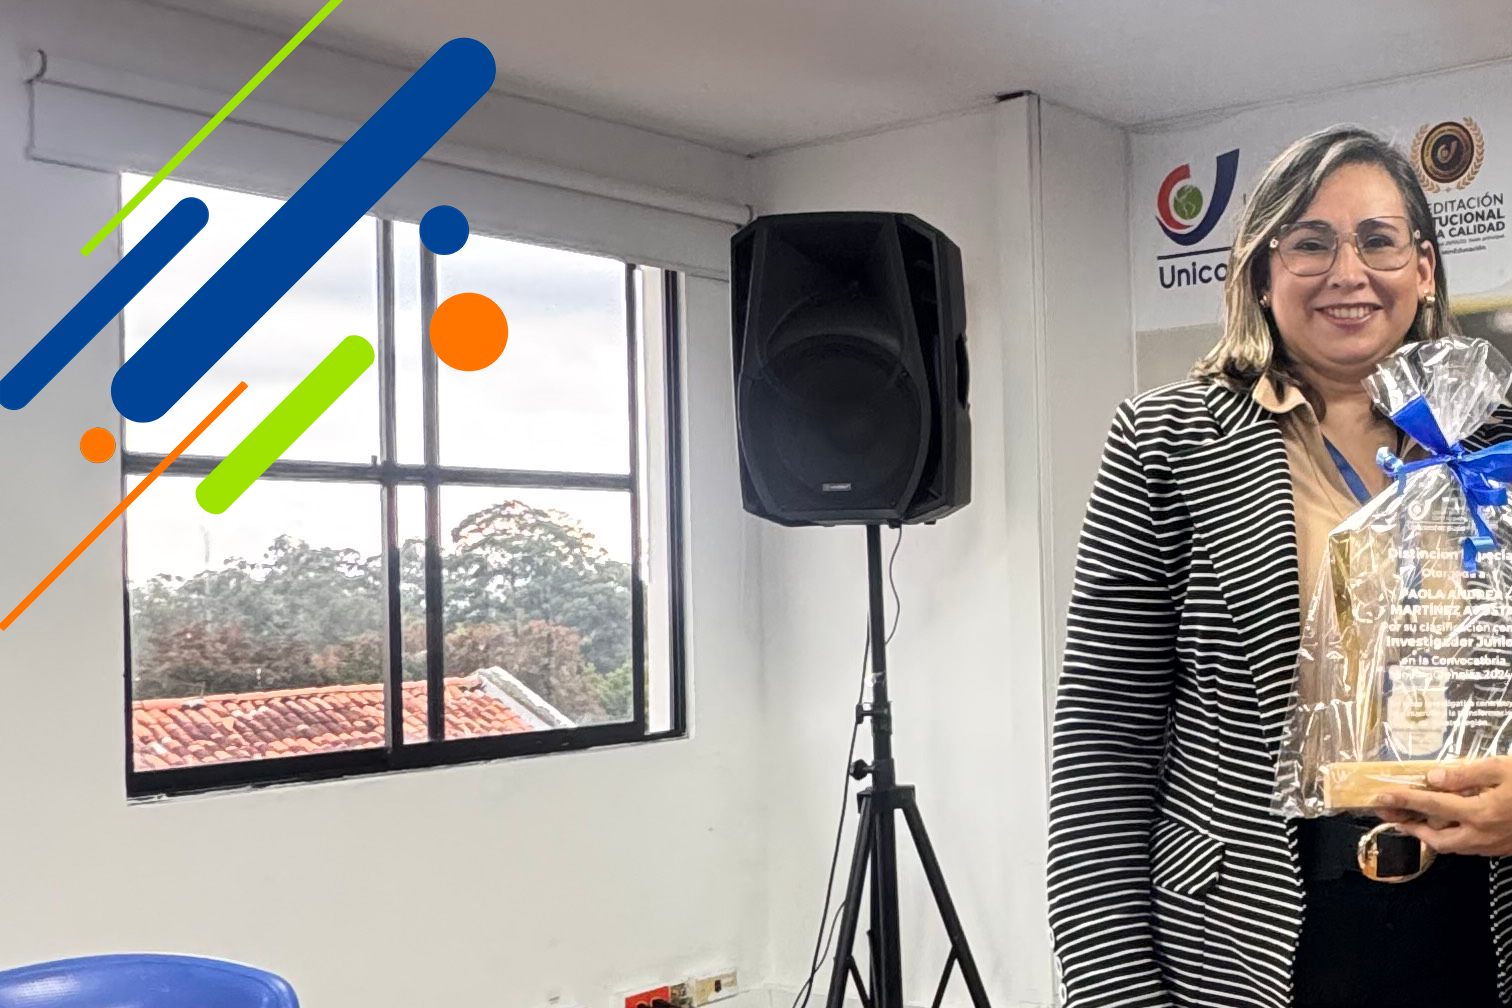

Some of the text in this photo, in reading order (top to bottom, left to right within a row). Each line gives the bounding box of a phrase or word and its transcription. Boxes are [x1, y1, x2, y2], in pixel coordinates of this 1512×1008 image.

[1448, 221, 1506, 238] CALIDAD
[1399, 587, 1503, 600] PAOLA ANDREA
[1391, 602, 1461, 616] MARTÍNEZ
[1404, 623, 1417, 634] su
[1386, 635, 1474, 650] Investigador
